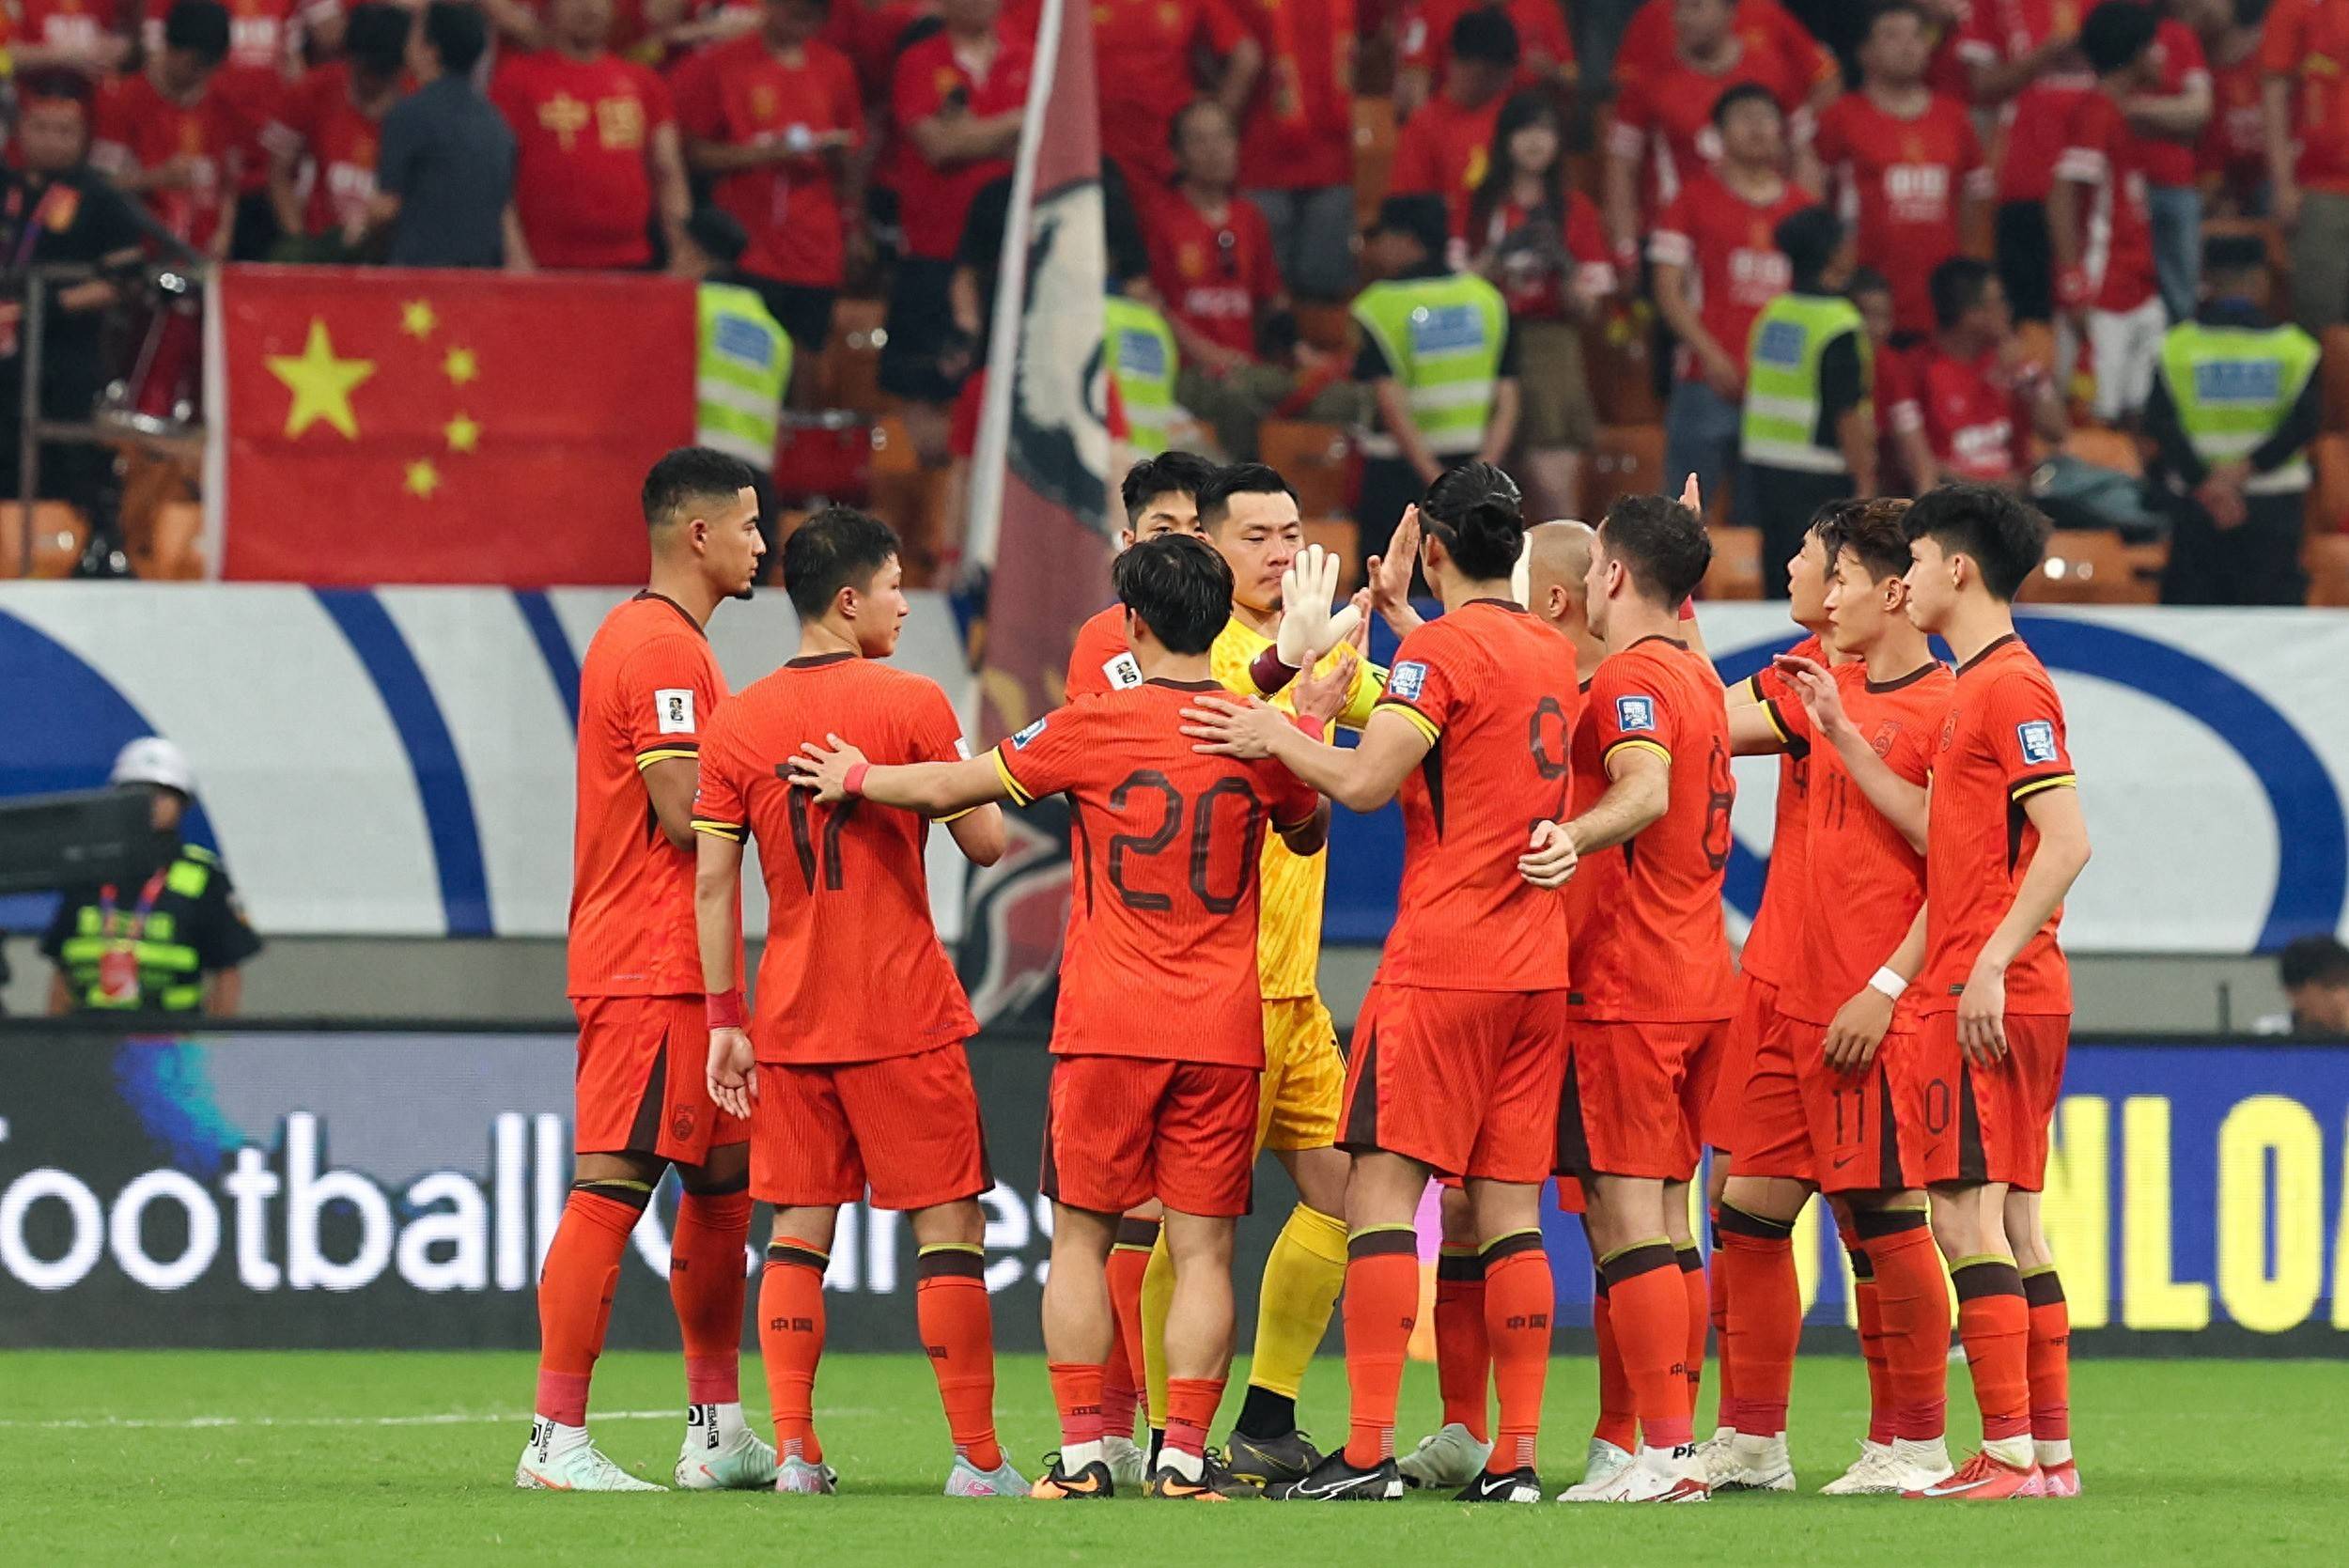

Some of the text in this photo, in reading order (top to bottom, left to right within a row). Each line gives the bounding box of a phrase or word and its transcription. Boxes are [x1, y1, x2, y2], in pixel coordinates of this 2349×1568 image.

[773, 762, 863, 896] 17
[1529, 696, 1569, 832] 9
[1702, 735, 1734, 871] 8
[1825, 772, 1846, 831] 11
[1109, 768, 1264, 915] 20
[1832, 1088, 1864, 1145] 11
[0, 1110, 564, 1292] ootball
